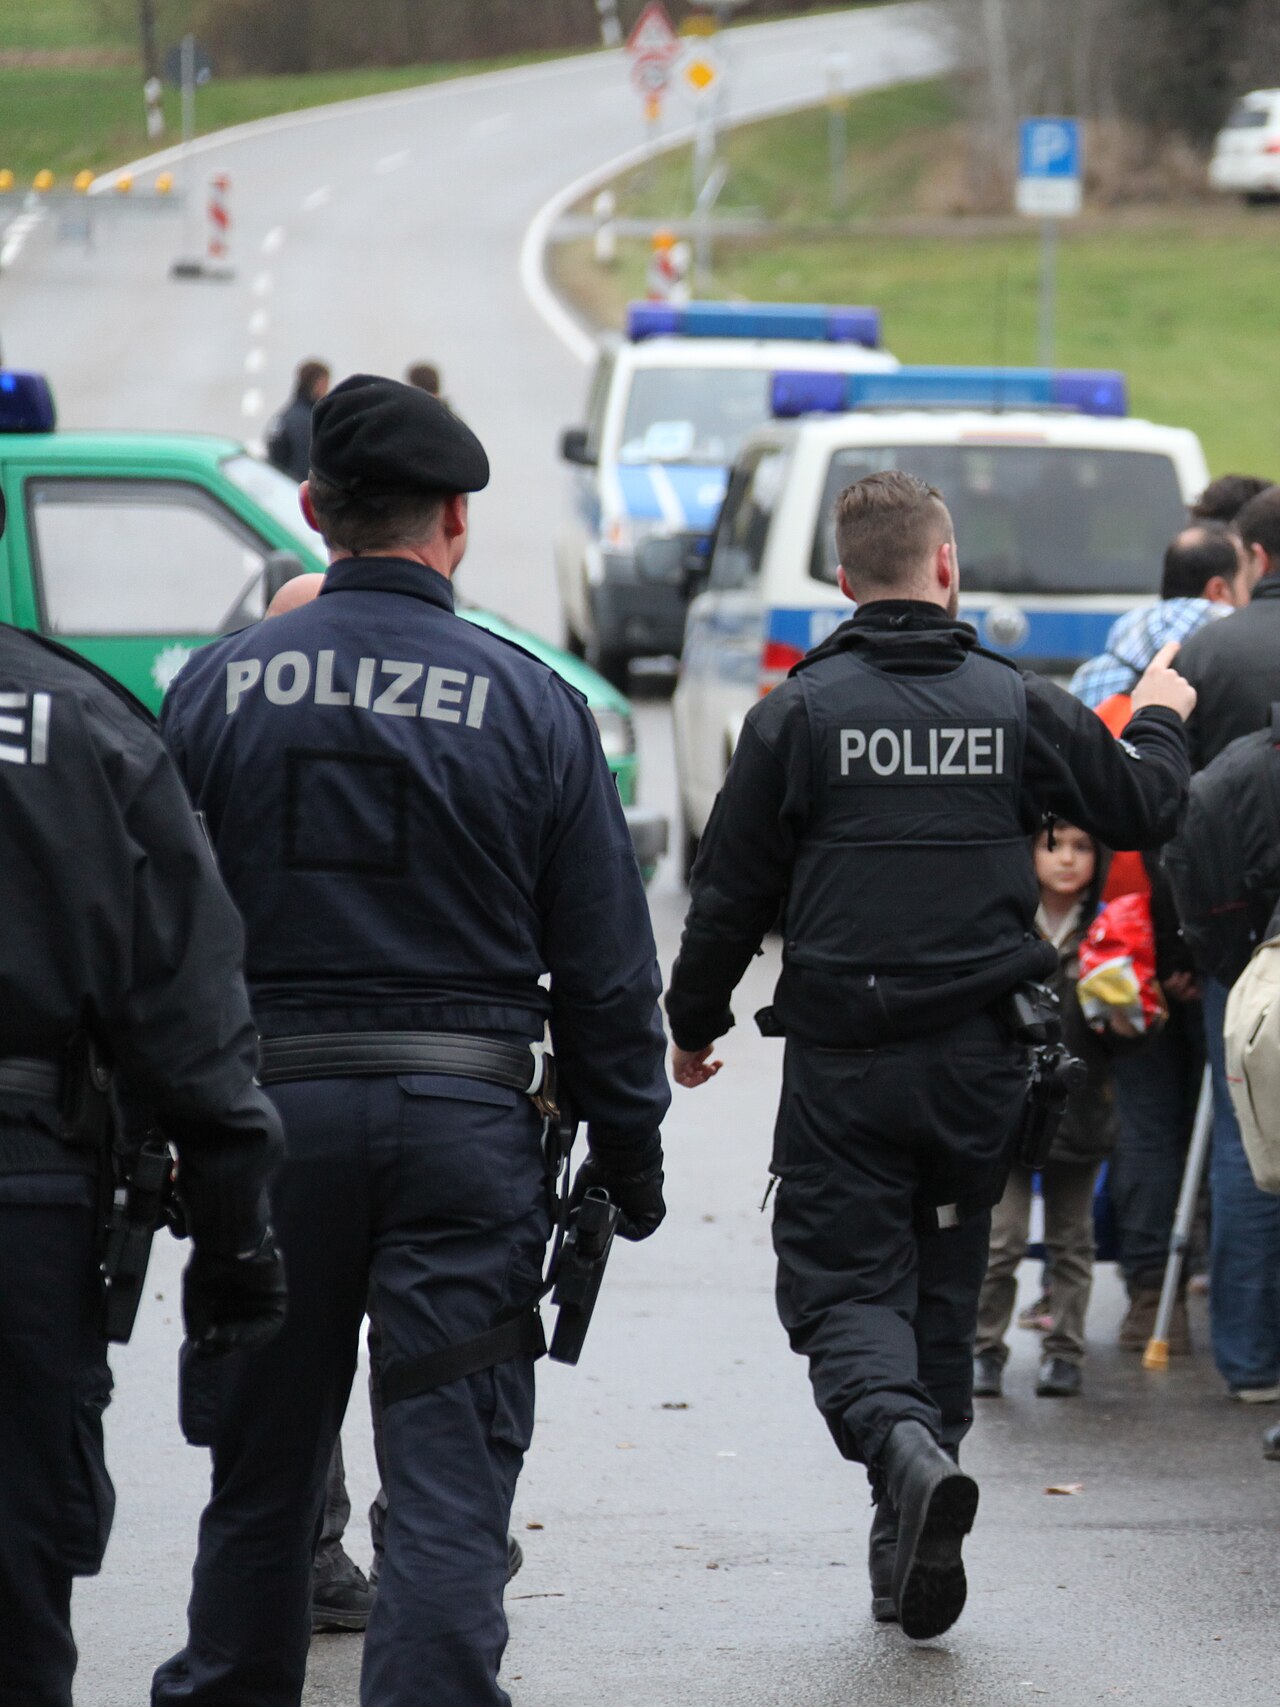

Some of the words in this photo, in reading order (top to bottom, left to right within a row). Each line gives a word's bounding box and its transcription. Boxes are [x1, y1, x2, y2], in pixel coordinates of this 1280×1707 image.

[1033, 124, 1068, 166] P
[226, 650, 489, 730] POLIZEI
[840, 728, 1003, 776] POLIZEI
